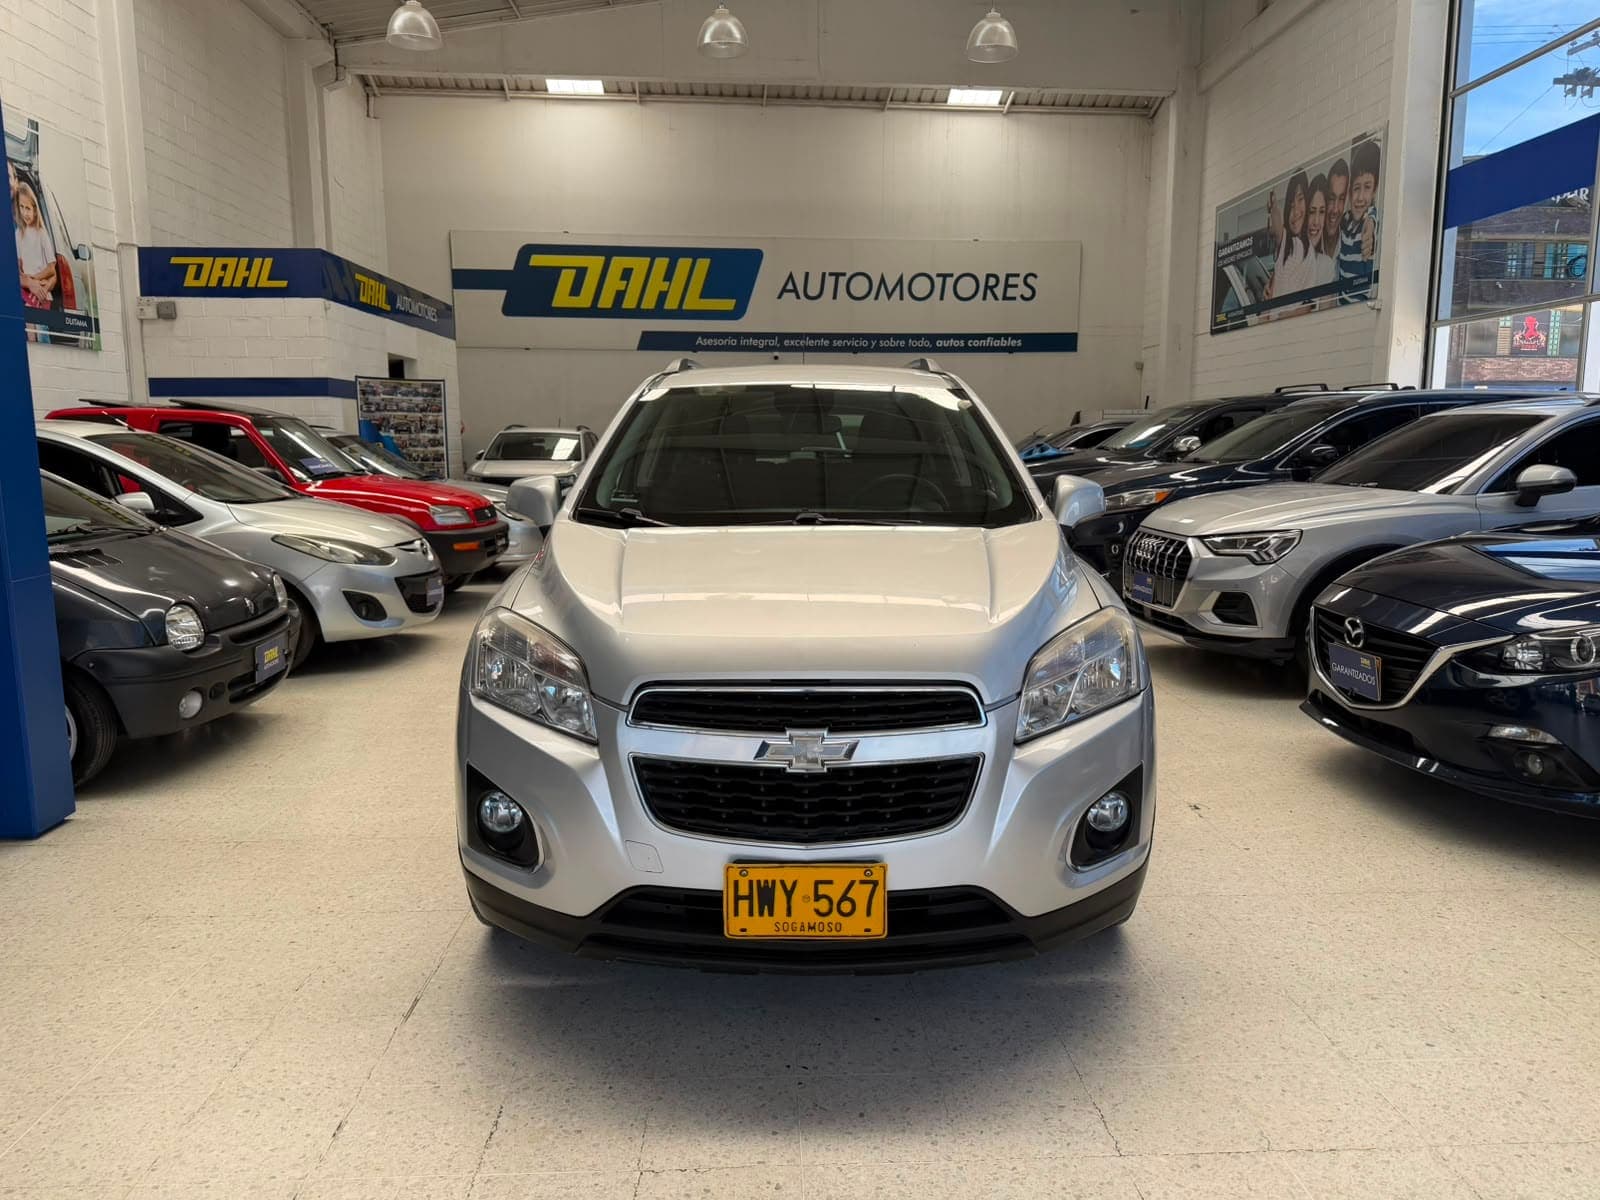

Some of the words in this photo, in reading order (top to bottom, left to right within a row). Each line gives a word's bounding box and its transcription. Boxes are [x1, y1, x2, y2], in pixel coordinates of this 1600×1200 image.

[169, 256, 288, 288] DAHL
[529, 254, 737, 311] DAHL
[777, 270, 1039, 302] AUTOMOTORES
[354, 272, 392, 312] DAHL
[395, 293, 438, 323] AUTOMOTORES
[740, 335, 780, 349] integral,
[783, 336, 830, 347] excelente
[832, 336, 868, 348] servicio
[870, 339, 877, 349] y
[879, 337, 906, 348] sobre
[908, 338, 933, 349] todo,
[936, 338, 965, 348] autos
[967, 337, 1022, 348] confiables
[1331, 662, 1376, 686] GARANTIZADOS
[733, 879, 798, 918] HWY
[813, 879, 880, 918] 567
[774, 921, 843, 933] SOGAMOSO
